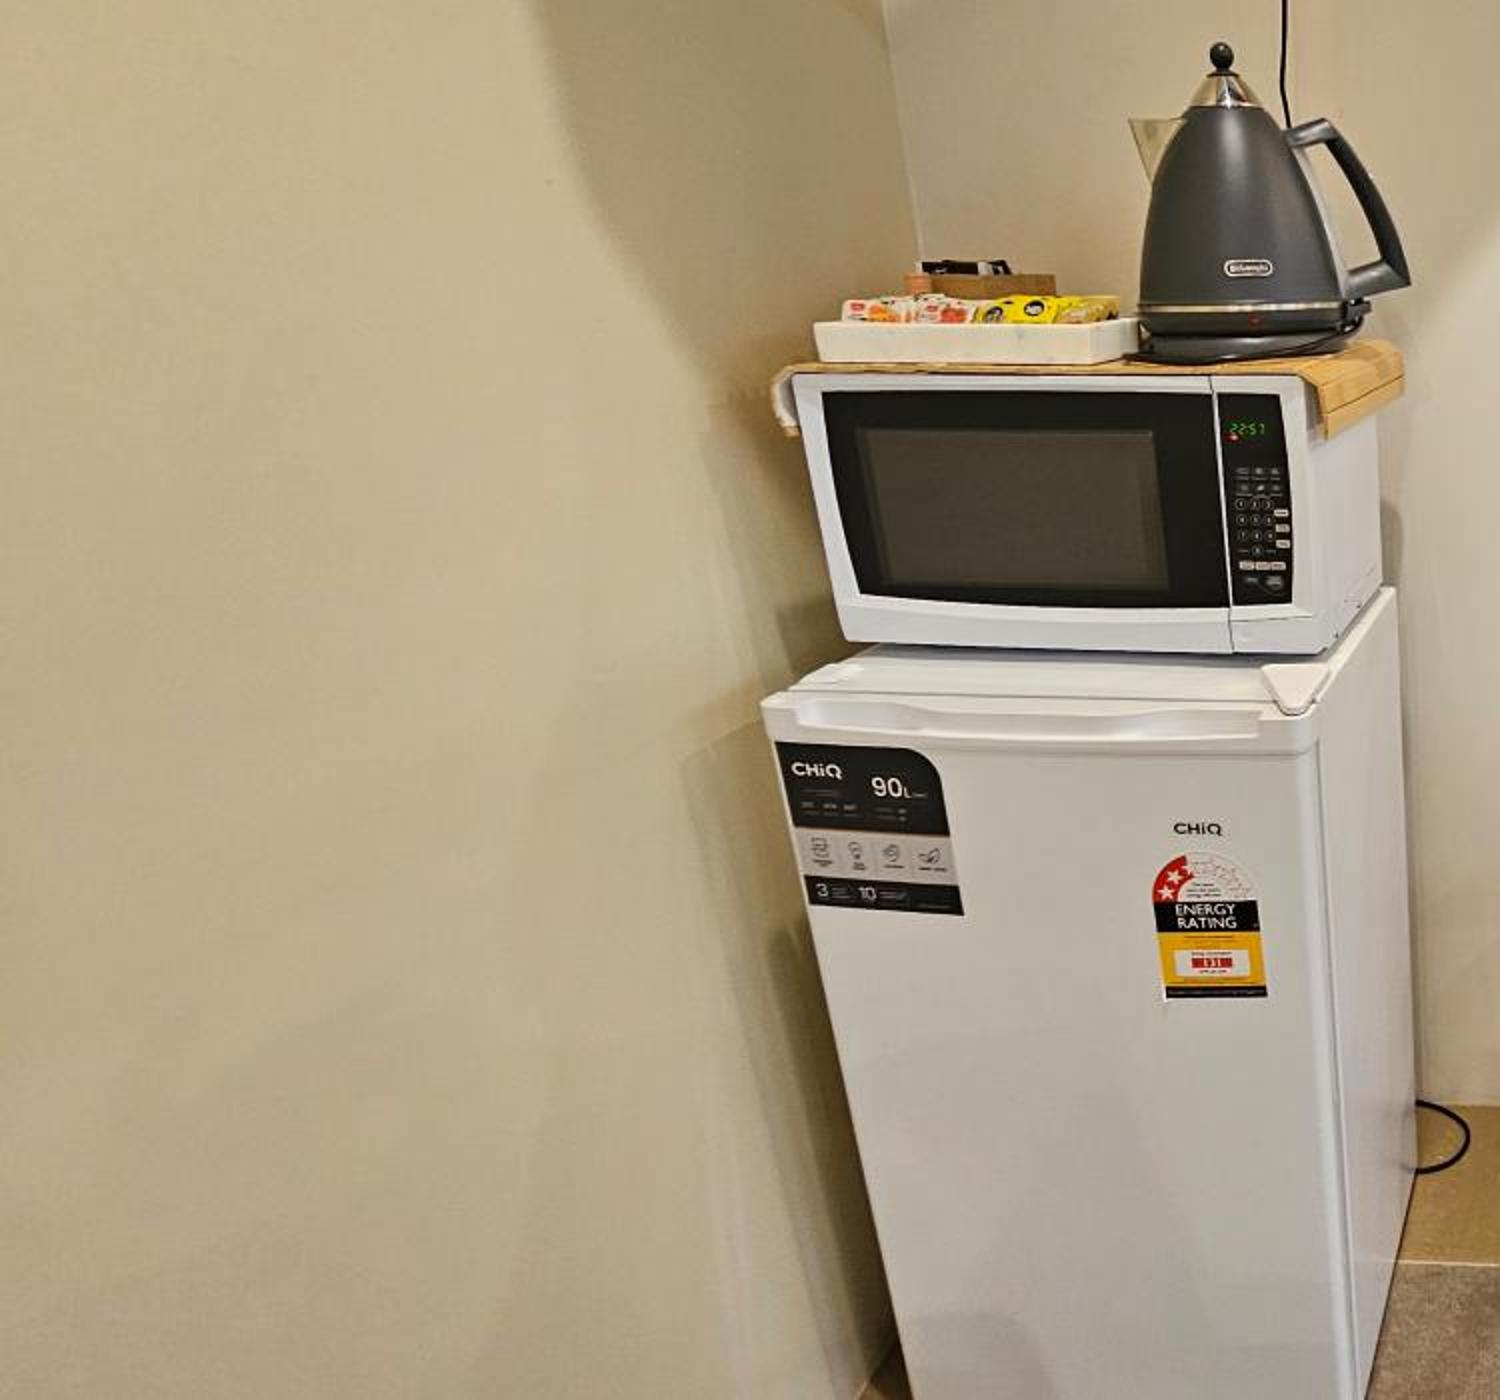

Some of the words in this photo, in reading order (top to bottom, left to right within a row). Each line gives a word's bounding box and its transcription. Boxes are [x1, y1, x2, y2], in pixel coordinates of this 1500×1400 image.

[815, 883, 829, 897] 3
[1175, 903, 1236, 916] ENERGY
[1177, 916, 1237, 929] RATING
